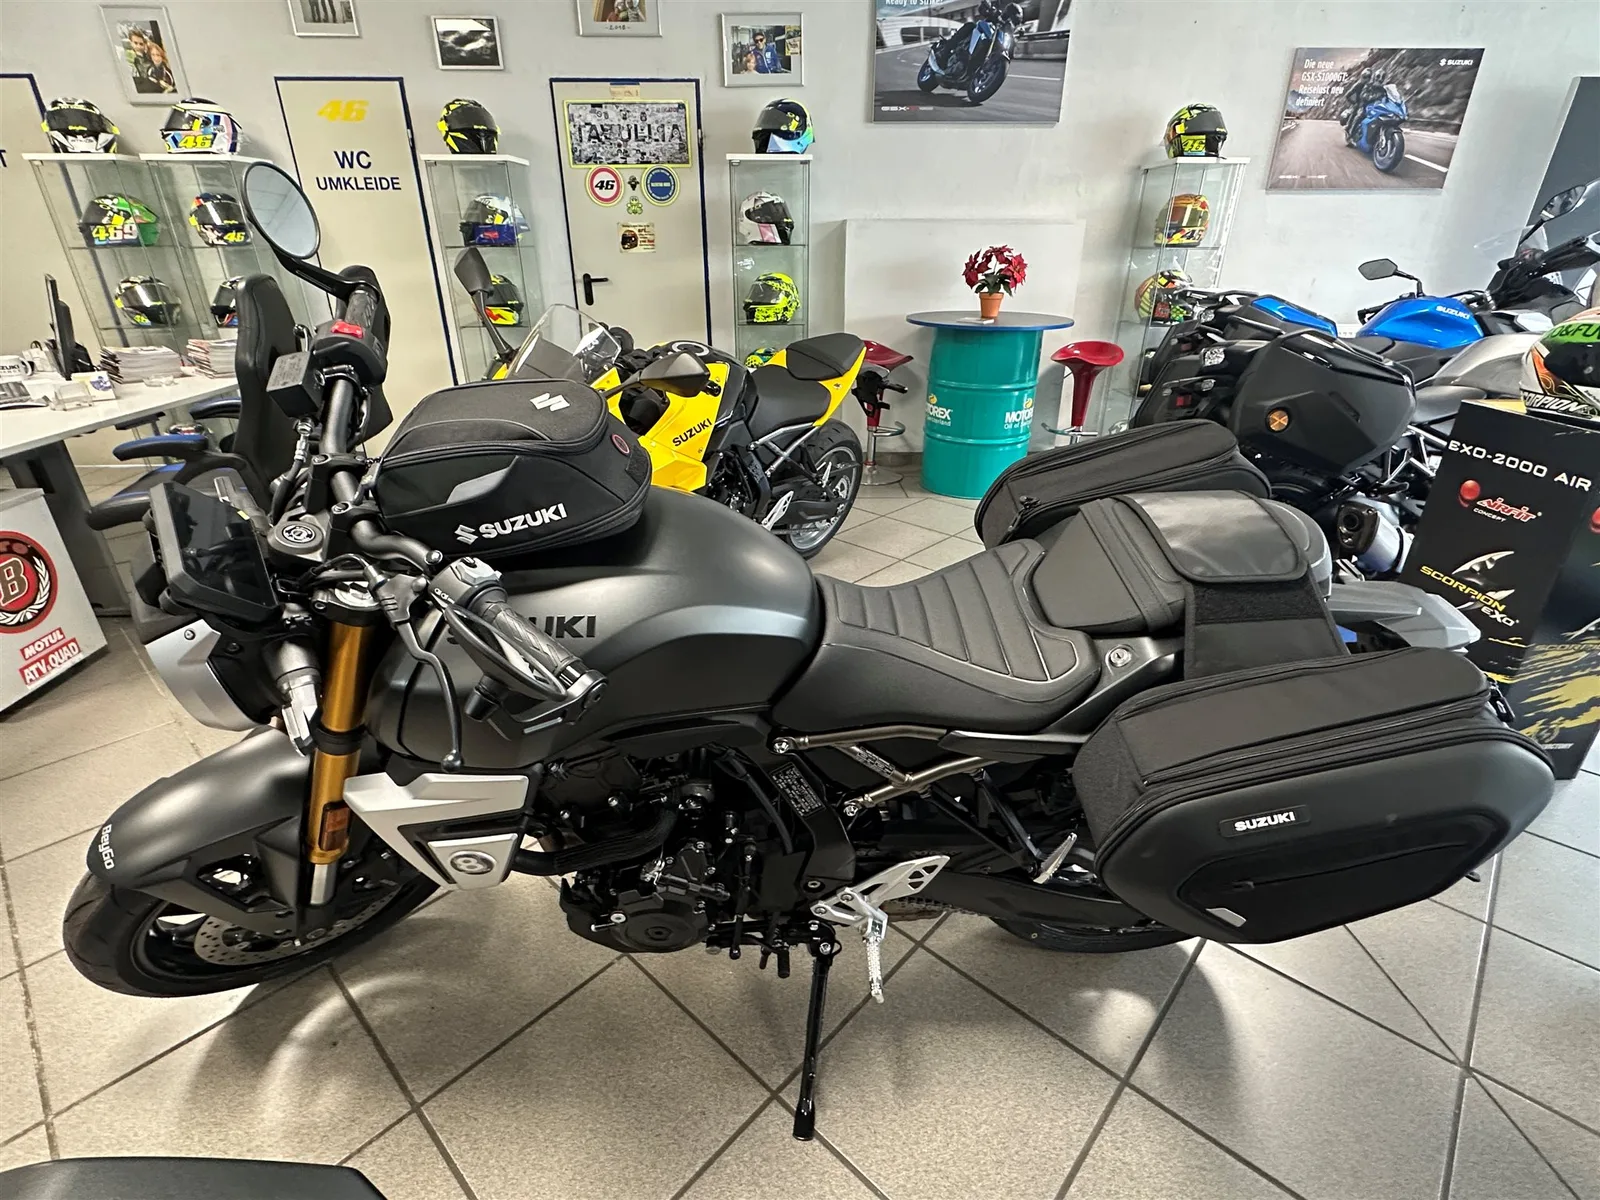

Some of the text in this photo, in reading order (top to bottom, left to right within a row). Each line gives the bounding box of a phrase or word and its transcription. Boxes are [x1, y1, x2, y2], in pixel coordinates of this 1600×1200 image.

[1304, 58, 1335, 69] Die neue
[1299, 84, 1345, 94] Reiselust neu
[1296, 96, 1325, 107] definiert
[317, 99, 369, 122] 46
[178, 134, 213, 149] 46
[1183, 139, 1206, 152] 46
[333, 150, 372, 169] WC
[315, 176, 402, 191] UMKLEIDE
[594, 179, 615, 190] 46
[223, 231, 245, 242] 46
[1436, 305, 1470, 320] SUZUKI
[672, 418, 713, 447] SUZUKI
[1448, 439, 1592, 492] EXO-2000 AIR
[479, 503, 567, 539] SUZUKI
[1473, 507, 1507, 523] CONCEPT
[0, 557, 28, 606] B
[1419, 565, 1505, 612] SCORPION
[23, 629, 65, 660] MOTUL
[1234, 811, 1296, 832] SUZUKI
[98, 823, 115, 870] BeyGo
